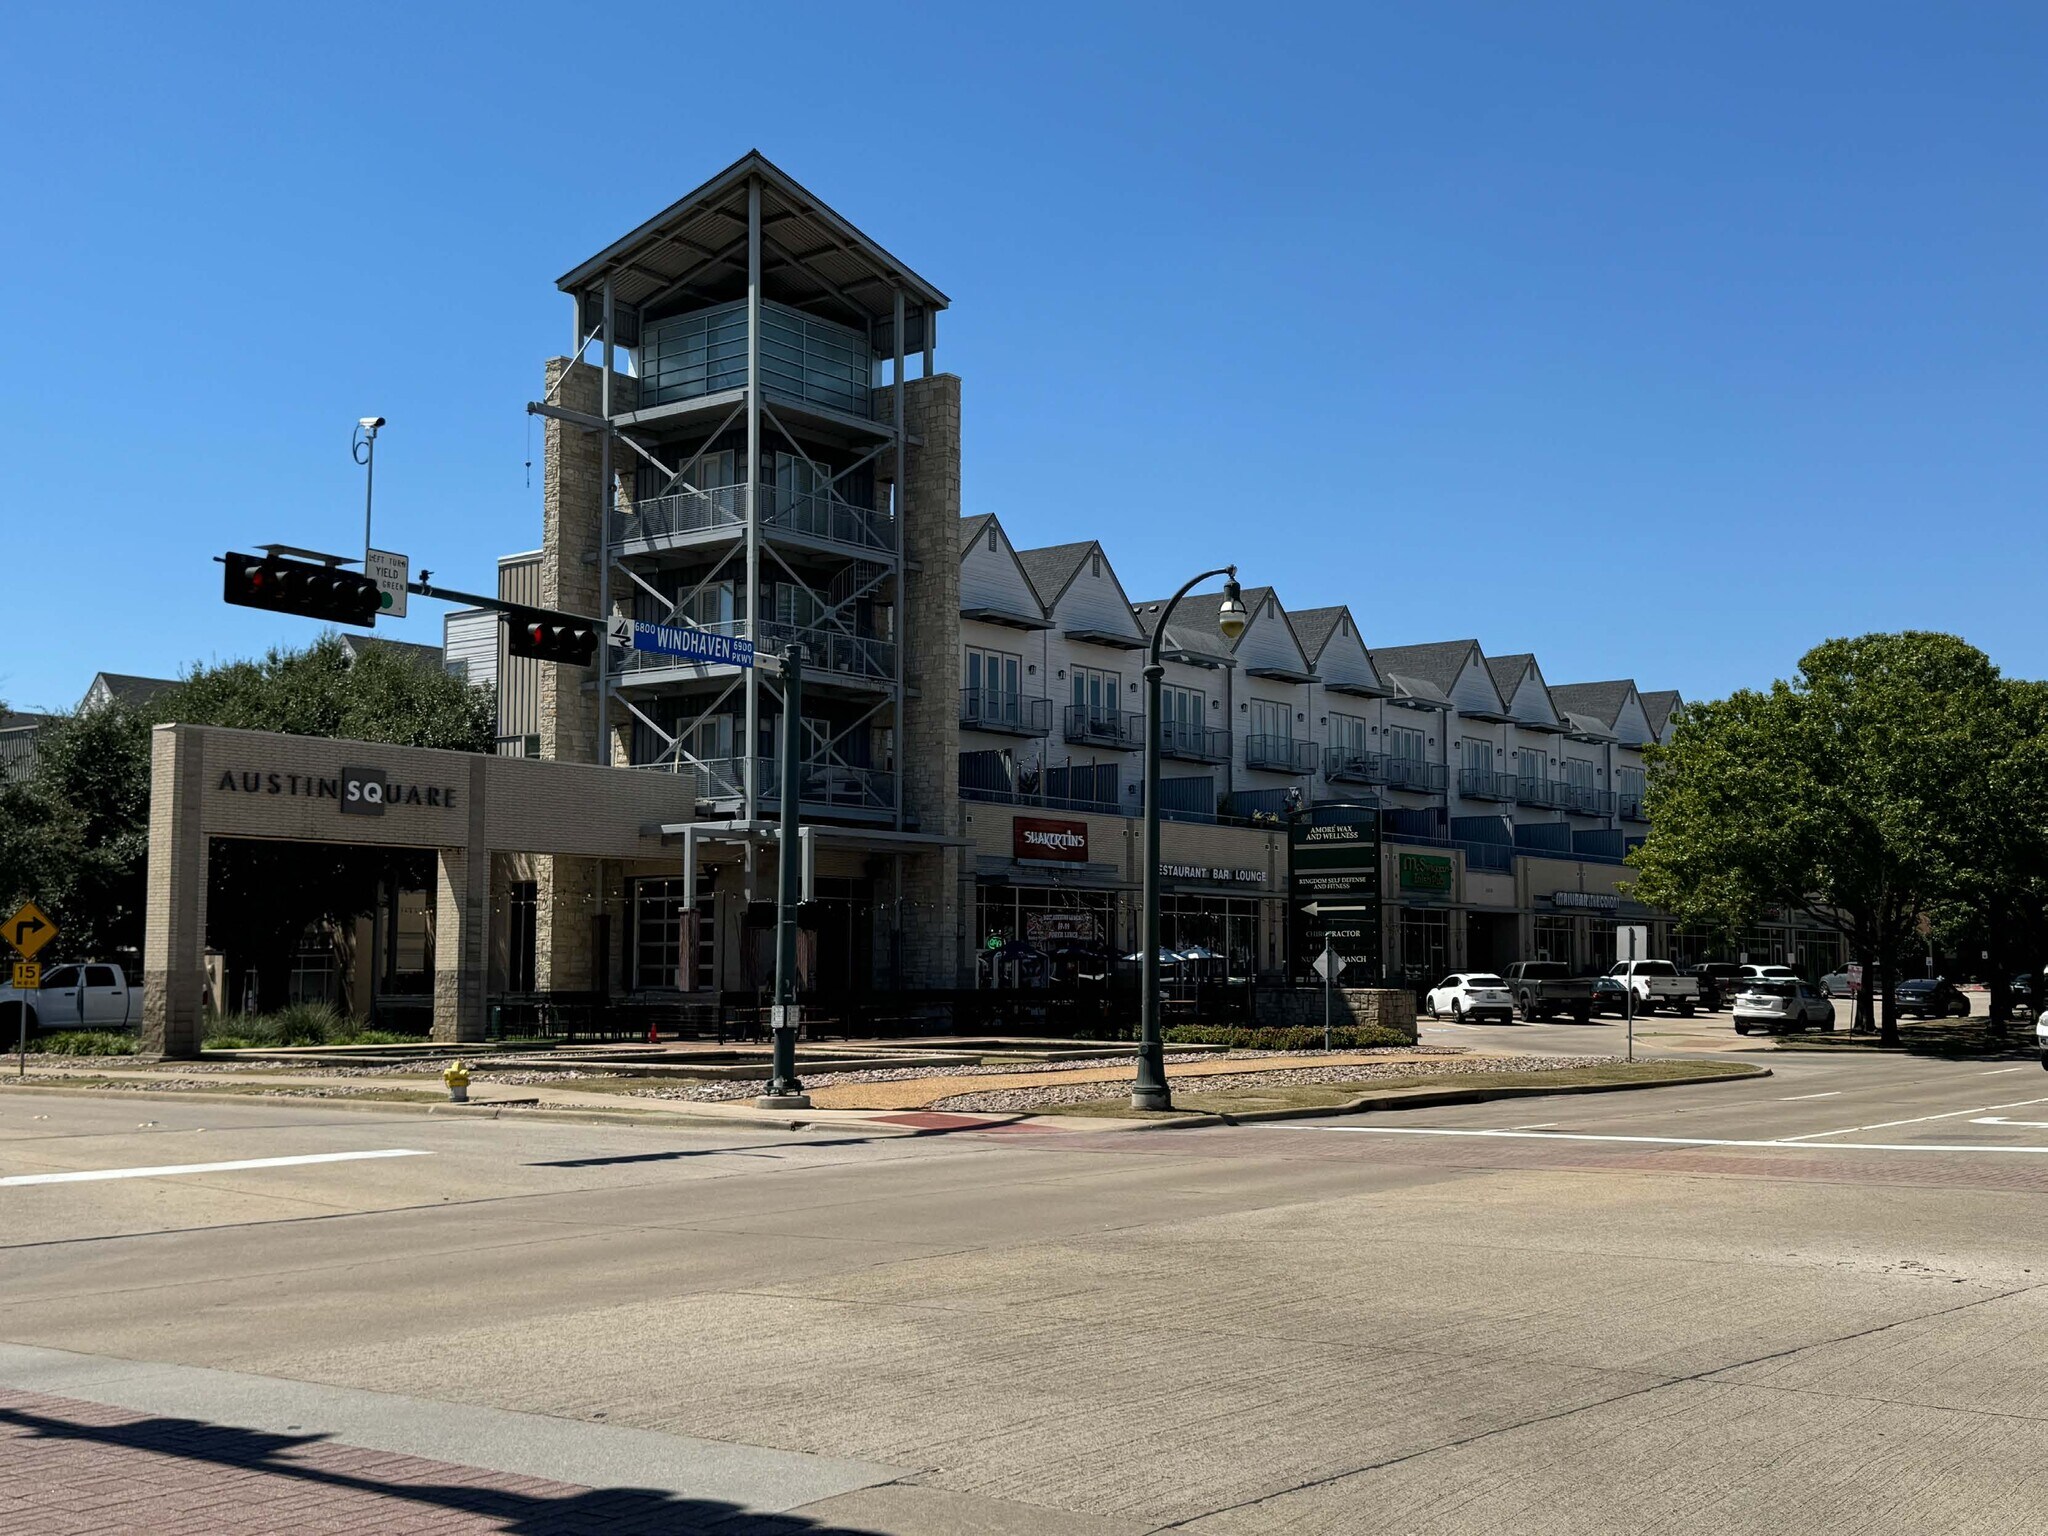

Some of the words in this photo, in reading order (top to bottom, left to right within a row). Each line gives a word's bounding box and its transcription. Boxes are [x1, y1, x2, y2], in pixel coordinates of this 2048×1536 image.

[369, 554, 385, 564] LEFT
[376, 566, 399, 579] YIELD
[382, 580, 404, 591] GREEN
[635, 621, 656, 635] 6800
[657, 626, 730, 659] WINDHAVEN
[733, 640, 753, 653] 6900
[732, 652, 753, 665] PKWY
[218, 769, 338, 799] AUSTIN
[346, 780, 457, 809] SQUARE
[1323, 832, 1358, 840] WELLNESS
[1159, 864, 1206, 878] ESTAURANT
[1213, 868, 1229, 880] BAR
[1235, 870, 1267, 882] LOUNGE
[18, 966, 36, 979] 15
